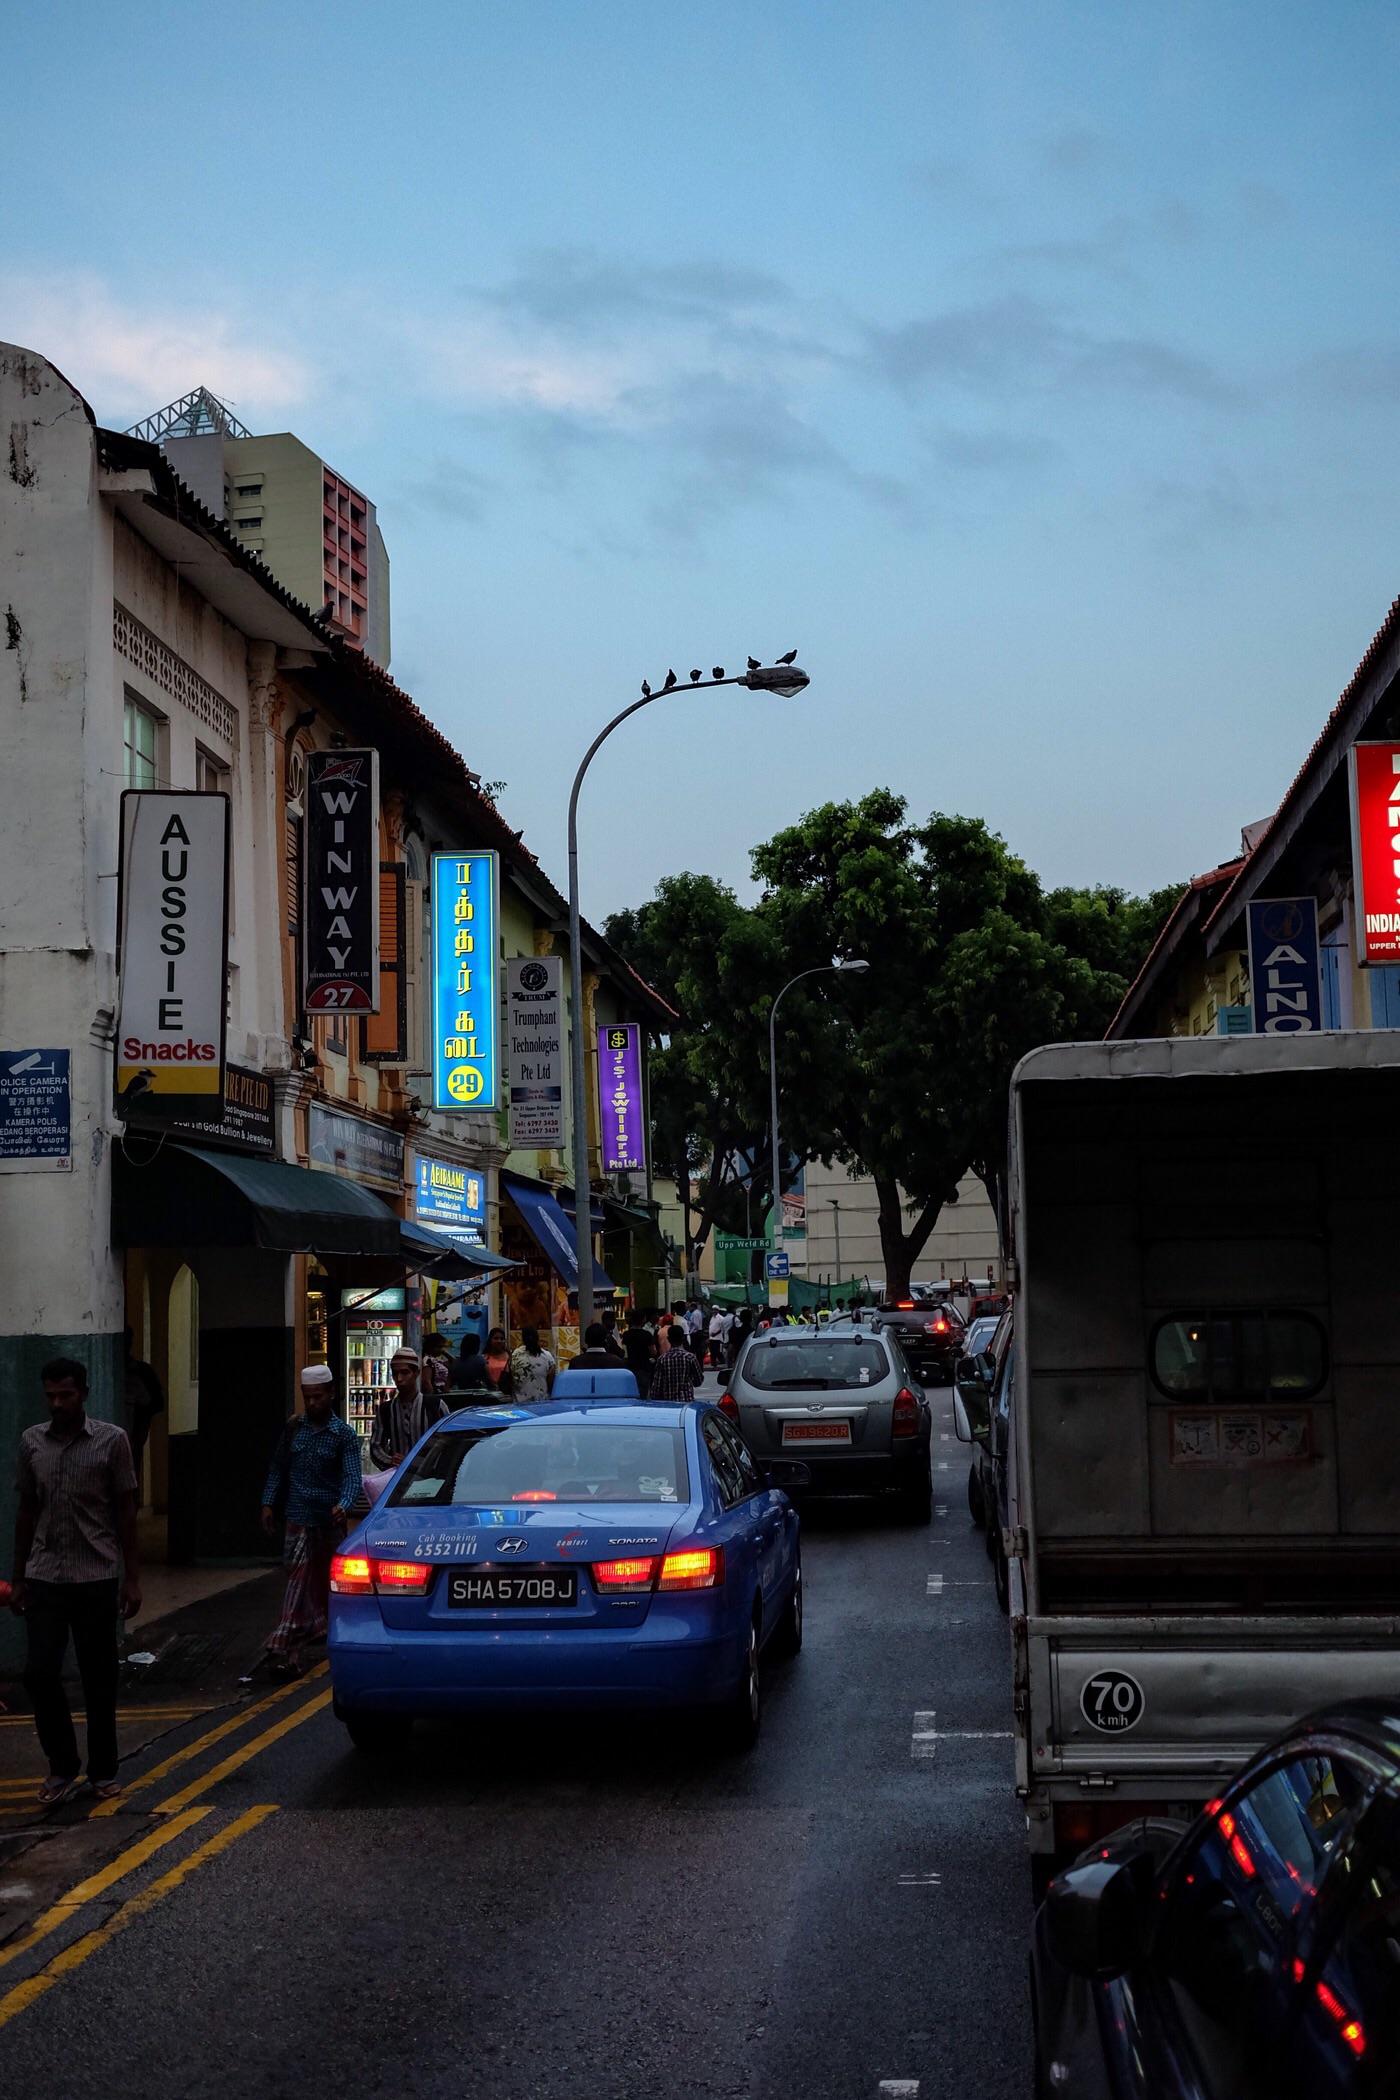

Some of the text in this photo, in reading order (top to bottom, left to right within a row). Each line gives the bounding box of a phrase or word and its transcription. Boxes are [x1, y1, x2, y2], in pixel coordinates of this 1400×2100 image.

[159, 814, 190, 1031] AUSSIE
[1369, 942, 1397, 950] UPPER
[323, 987, 355, 1007] 27
[513, 1009, 557, 1030] Trumphant
[123, 1038, 216, 1061] Snacks
[512, 1036, 559, 1057] Technologies
[521, 1063, 550, 1080] Pte Ltd
[0, 1077, 68, 1087] OLICE CAMERA
[453, 1073, 478, 1093] 29
[0, 1086, 63, 1096] IN OPERATION
[241, 1076, 254, 1106] PTE
[255, 1080, 270, 1110] LTD
[233, 1107, 254, 1120] Singapore
[611, 1082, 630, 1158] Jewellers
[5, 1118, 58, 1127] KAMERA POLIS
[0, 1126, 68, 1136] EDANG BEROPERASI
[203, 1121, 220, 1134] Gold
[220, 1124, 241, 1139] Bullion
[241, 1129, 247, 1141] &
[247, 1131, 274, 1148] Jewellery
[609, 1158, 637, 1169] Pte Ltd
[430, 1163, 465, 1190] ABIRAAME
[719, 1239, 770, 1249] Upp Weld Rd
[528, 1263, 545, 1277] LTD
[366, 1320, 384, 1330] 100
[418, 1533, 477, 1544] Cab Booking
[608, 1537, 658, 1546] SONATA
[414, 1543, 478, 1557] 6552 1111
[1091, 1681, 1135, 1712] 70
